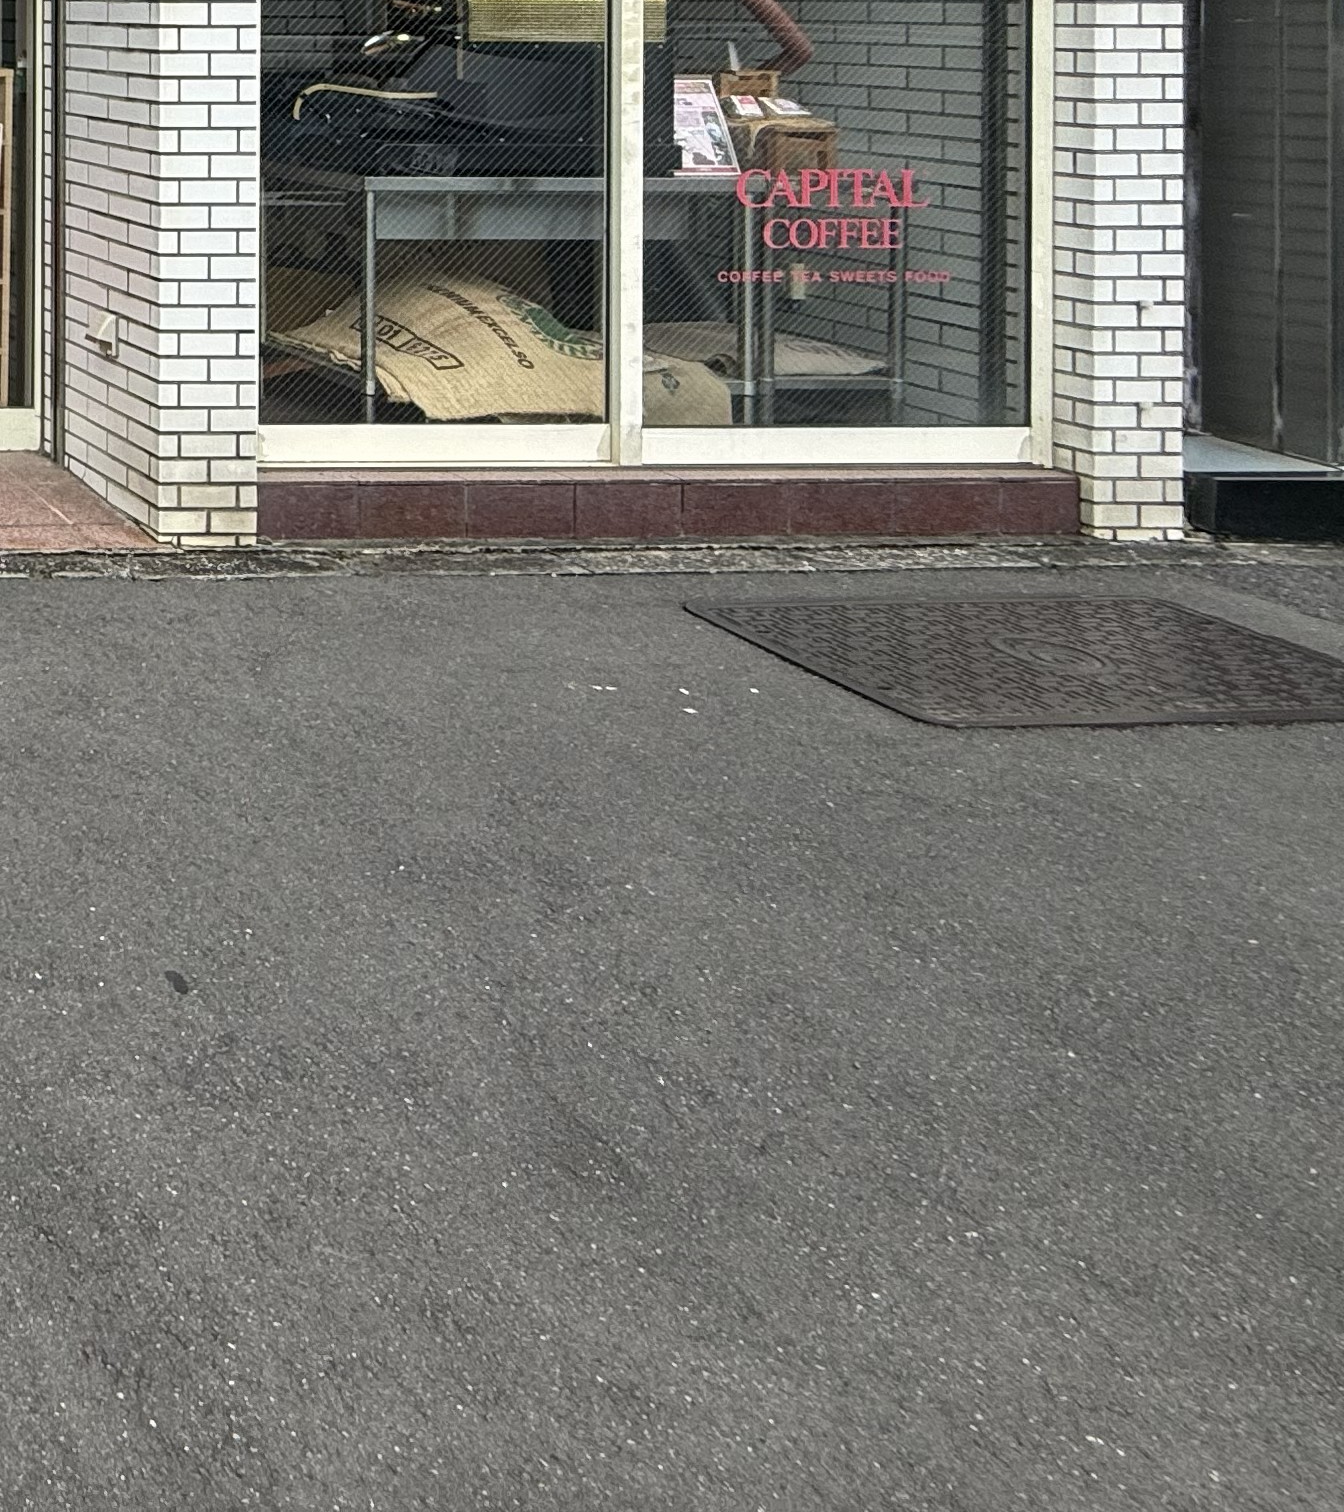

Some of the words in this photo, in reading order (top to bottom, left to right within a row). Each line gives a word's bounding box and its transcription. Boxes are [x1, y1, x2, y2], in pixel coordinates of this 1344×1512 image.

[735, 168, 931, 208] CAPITAL
[763, 218, 904, 250] COFFEE
[716, 270, 783, 284] COFFEE
[791, 270, 822, 284] TEA
[829, 270, 898, 284] SWEETS
[904, 270, 951, 284] FOOD
